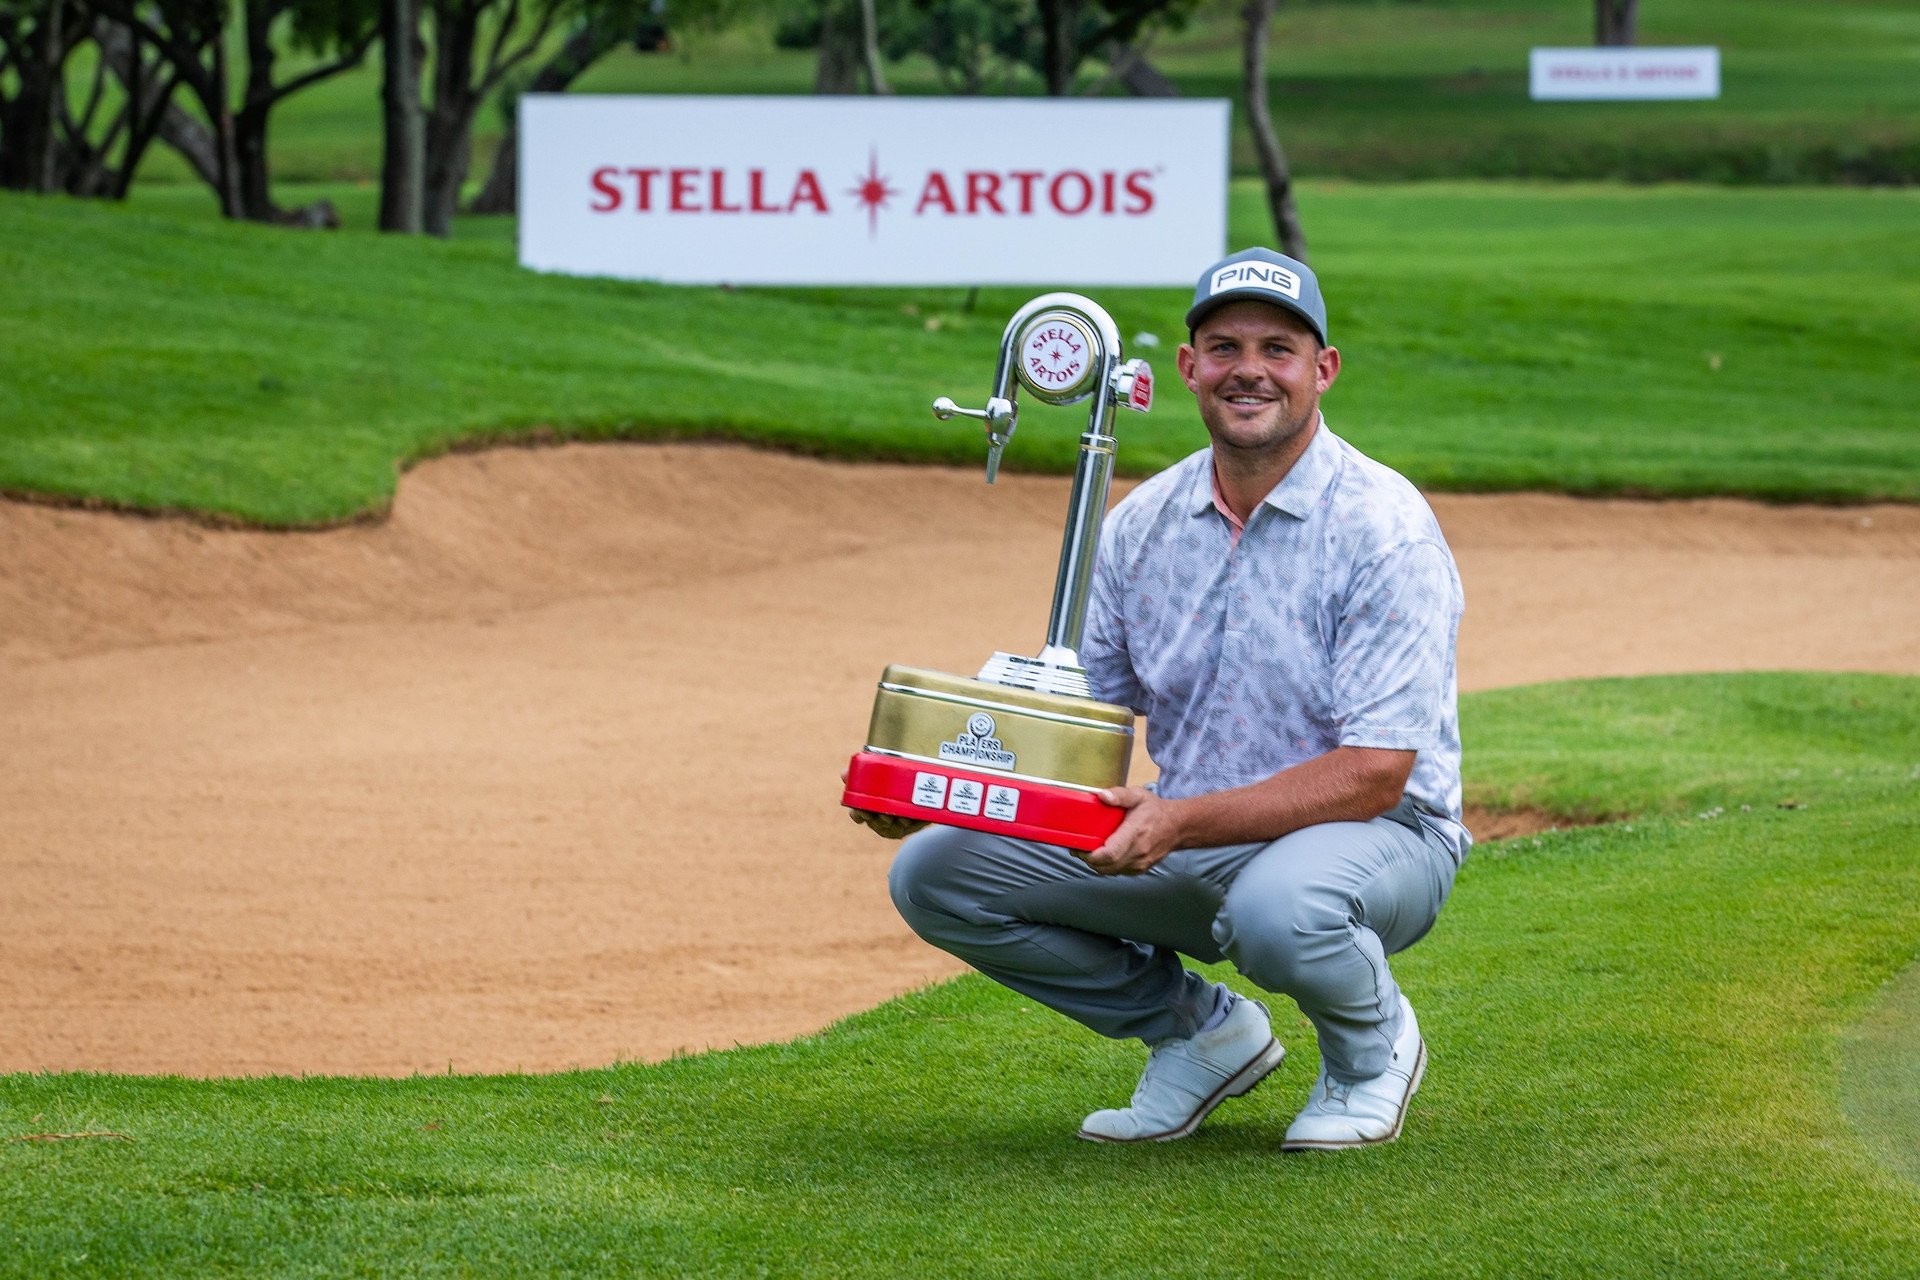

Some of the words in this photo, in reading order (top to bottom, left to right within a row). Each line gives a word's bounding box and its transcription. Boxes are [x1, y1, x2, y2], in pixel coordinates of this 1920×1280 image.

[589, 166, 829, 214] STELLA
[915, 169, 1157, 216] ARTOIS
[1217, 266, 1292, 290] PING
[1032, 328, 1082, 354] STELLA
[1030, 356, 1081, 383] ARTOIS
[941, 743, 1013, 763] CHAMPIONSHIP
